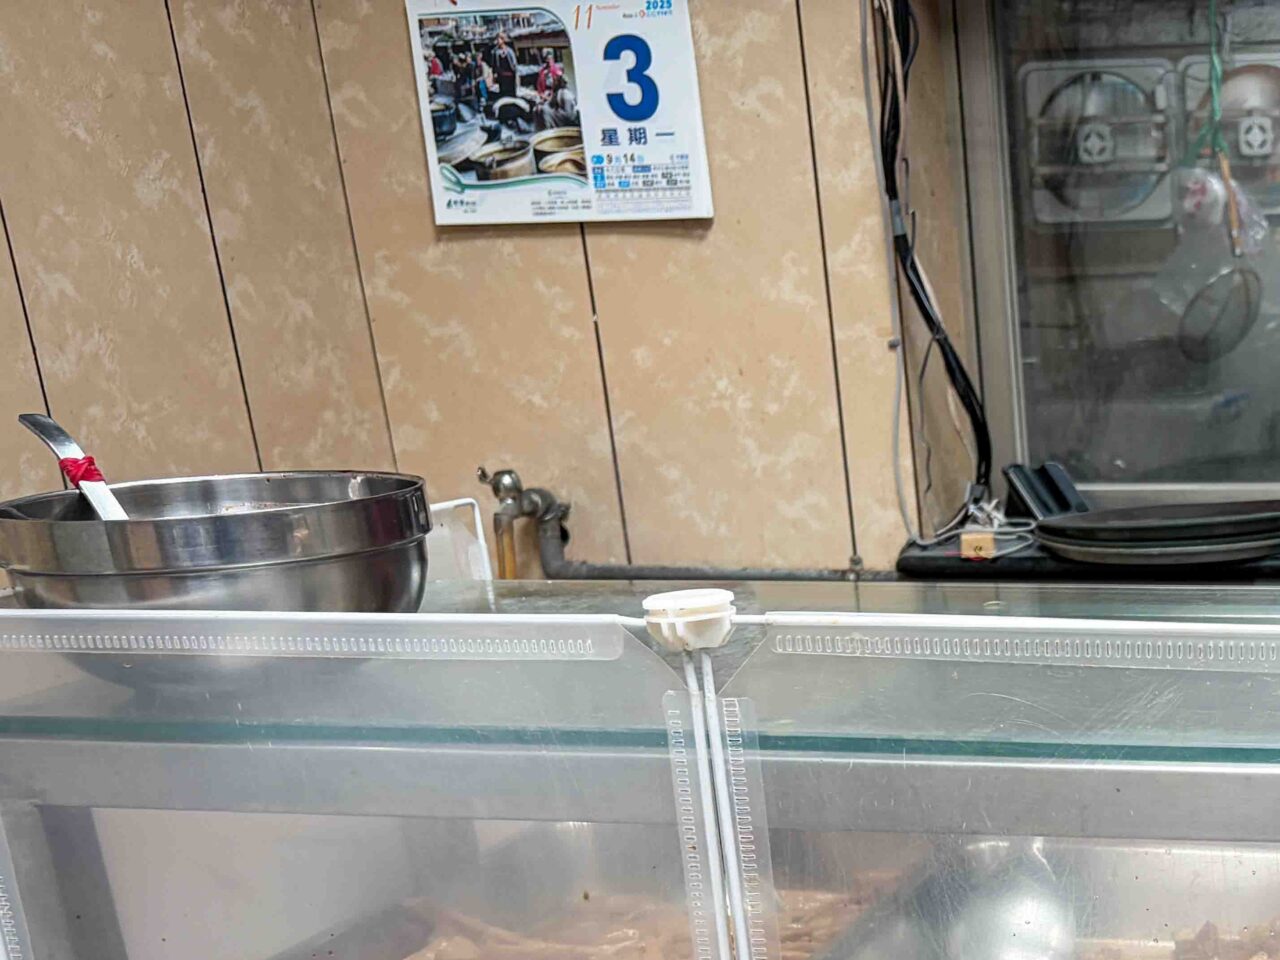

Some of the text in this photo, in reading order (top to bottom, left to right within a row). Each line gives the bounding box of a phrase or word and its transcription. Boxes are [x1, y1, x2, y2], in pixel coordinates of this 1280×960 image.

[646, 0, 672, 10] 2025
[573, 4, 592, 30] 11
[603, 34, 660, 122] 3
[600, 127, 675, 146] 星期一
